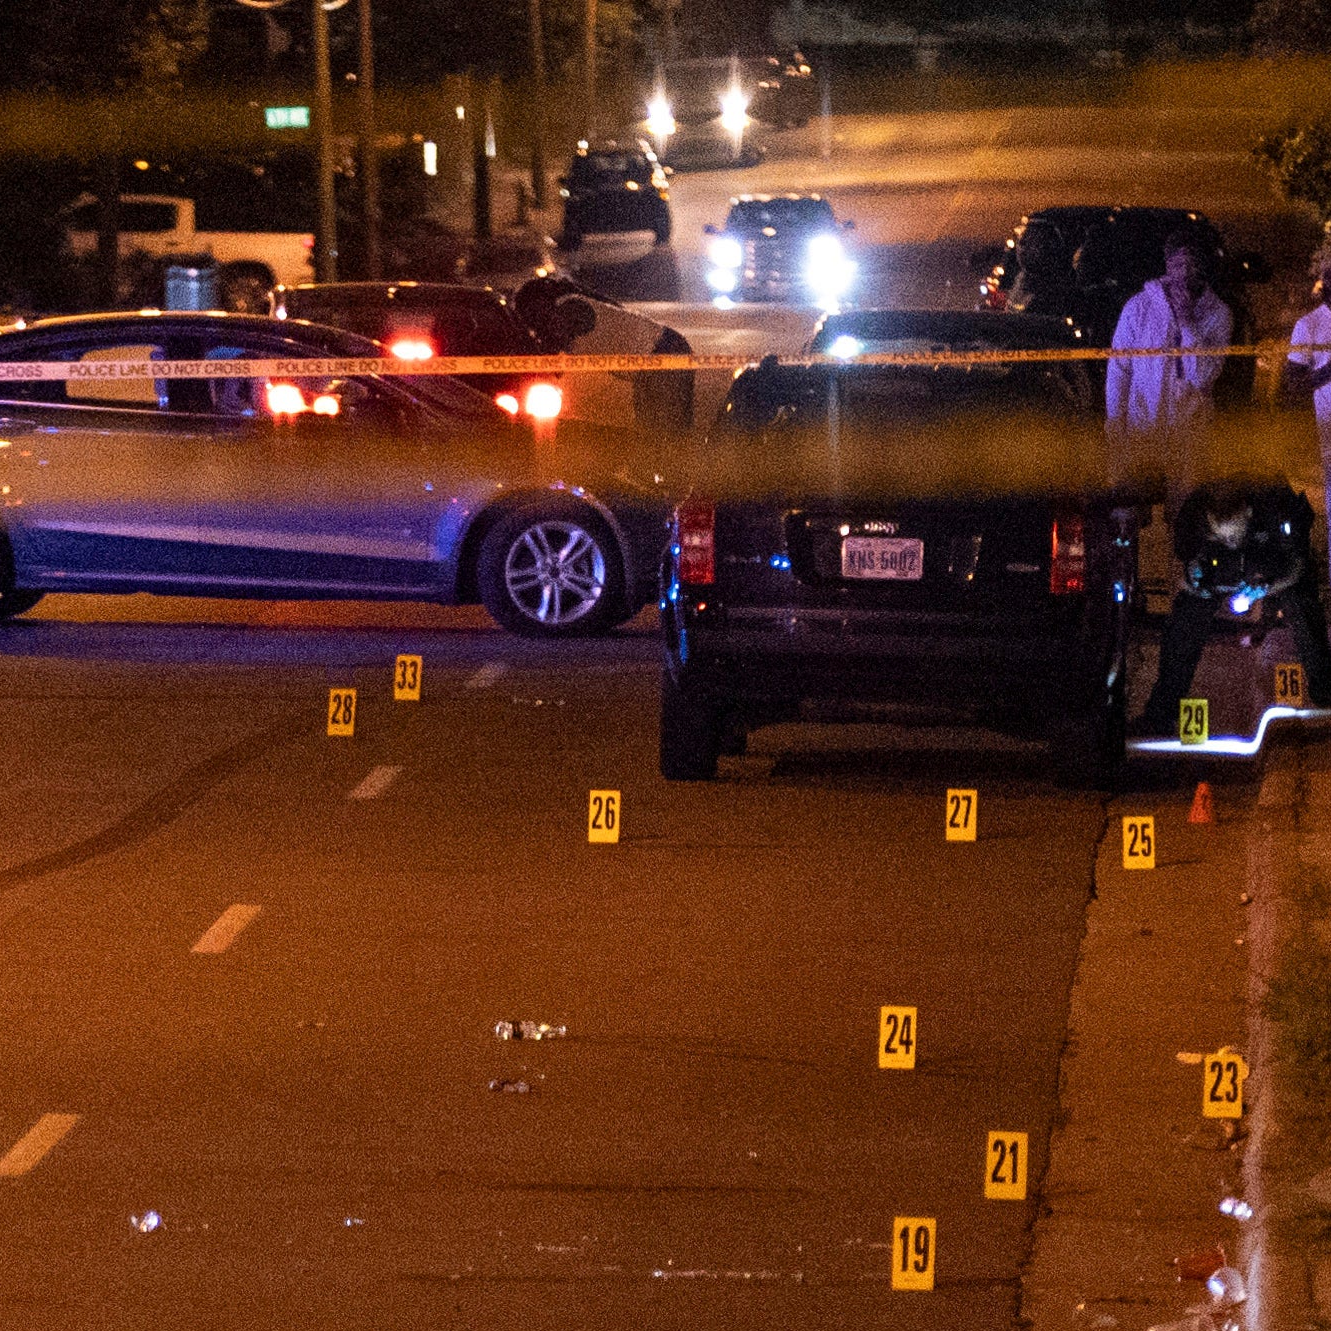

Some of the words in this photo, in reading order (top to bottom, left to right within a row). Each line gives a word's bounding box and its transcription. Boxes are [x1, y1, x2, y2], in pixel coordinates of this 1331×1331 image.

[69, 365, 116, 376] POLICE
[120, 364, 148, 376] LINE
[152, 364, 171, 375] DO
[175, 363, 201, 374] NOT
[204, 362, 251, 374] CROSS
[276, 362, 322, 373] POLICE
[327, 361, 355, 373] LINE
[359, 361, 379, 372] DO
[483, 359, 530, 370] POLICE
[533, 358, 561, 369] LINE
[565, 357, 584, 368] DO
[588, 357, 613, 368] NOT
[617, 356, 662, 367] CROSS
[397, 660, 419, 692] 33
[1278, 668, 1301, 698] 36
[331, 692, 355, 726] 28
[1182, 703, 1206, 738] 29
[591, 795, 616, 831] 26
[948, 793, 973, 830] 27
[1128, 821, 1153, 857] 25
[884, 1013, 914, 1056] 24
[1209, 1060, 1239, 1103] 23
[990, 1138, 1019, 1185] 21
[899, 1225, 931, 1273] 19
